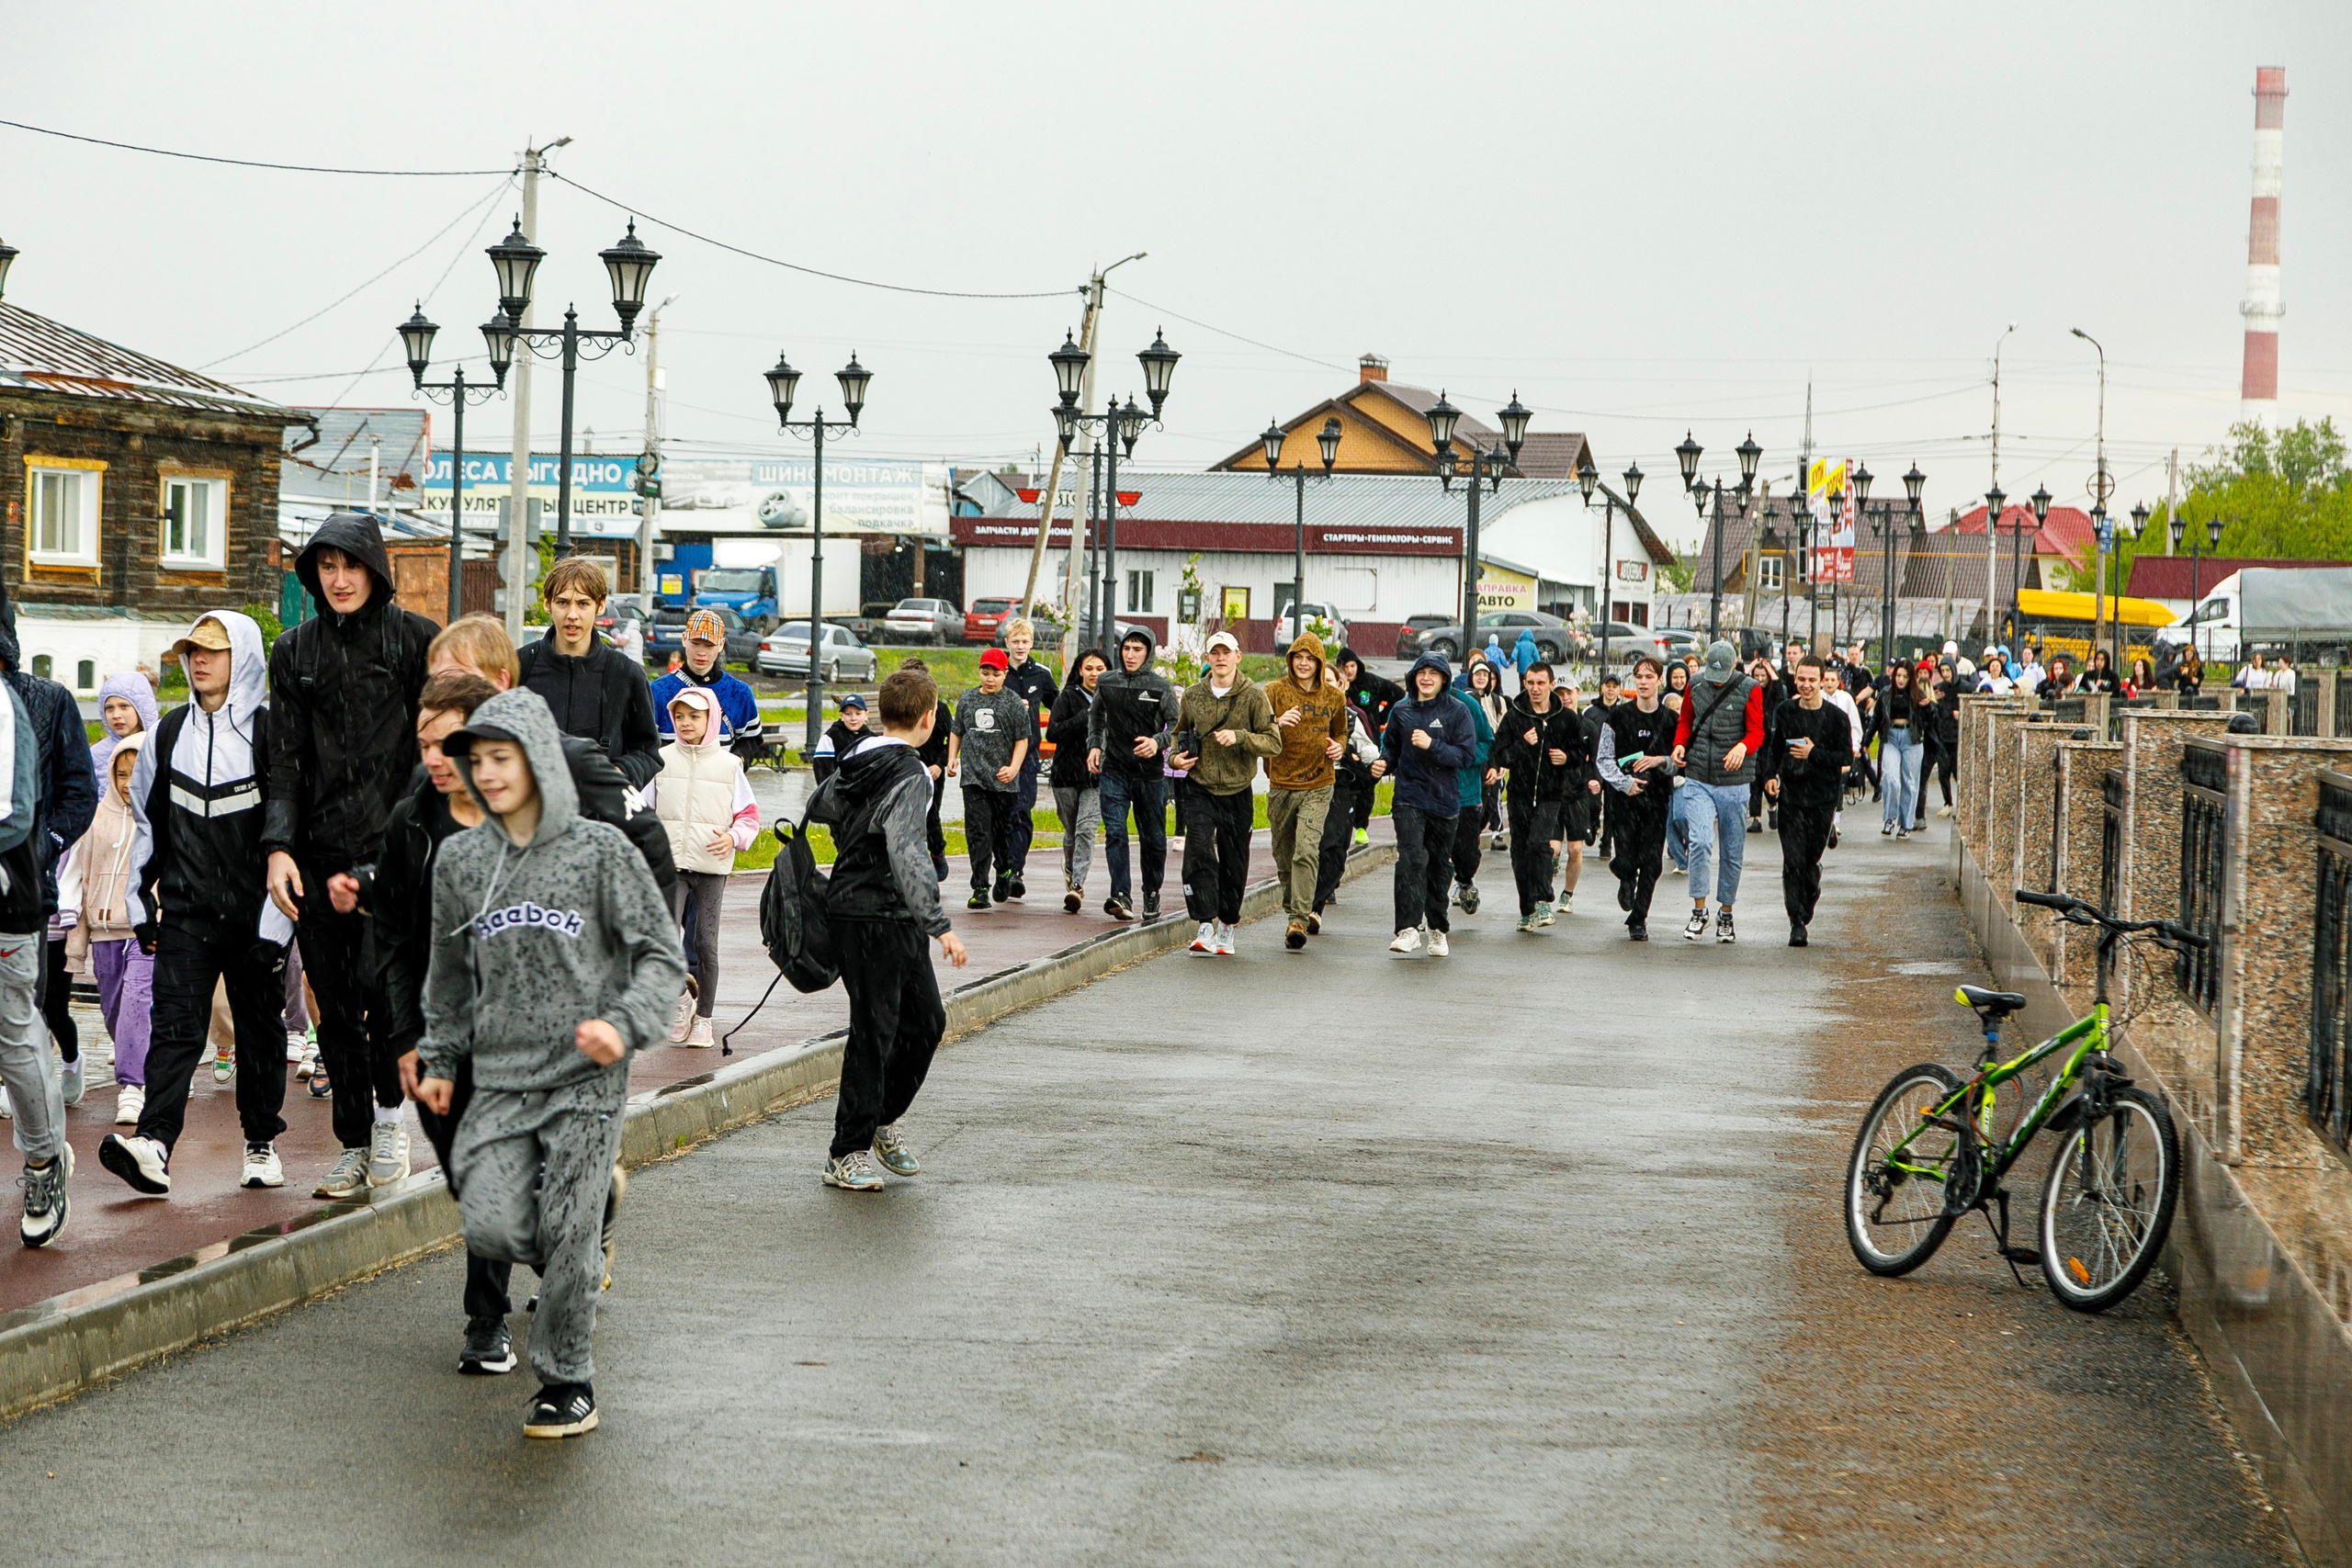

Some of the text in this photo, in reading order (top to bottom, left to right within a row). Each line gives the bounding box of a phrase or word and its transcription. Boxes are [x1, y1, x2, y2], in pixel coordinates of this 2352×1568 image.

[425, 459, 499, 480] ОЛЕСА
[573, 500, 628, 515] ЦЕНТР
[975, 525, 1019, 536] ЗАПЧАСТИ
[1020, 526, 1039, 536] ДЛЯ
[1323, 534, 1453, 545] СТАРТЕРЫ ГЕНЕРАТОРЫ СЕРВИС
[1475, 583, 1527, 593] АПРАВКА
[1477, 595, 1515, 606] АВТО
[975, 708, 994, 728] 6
